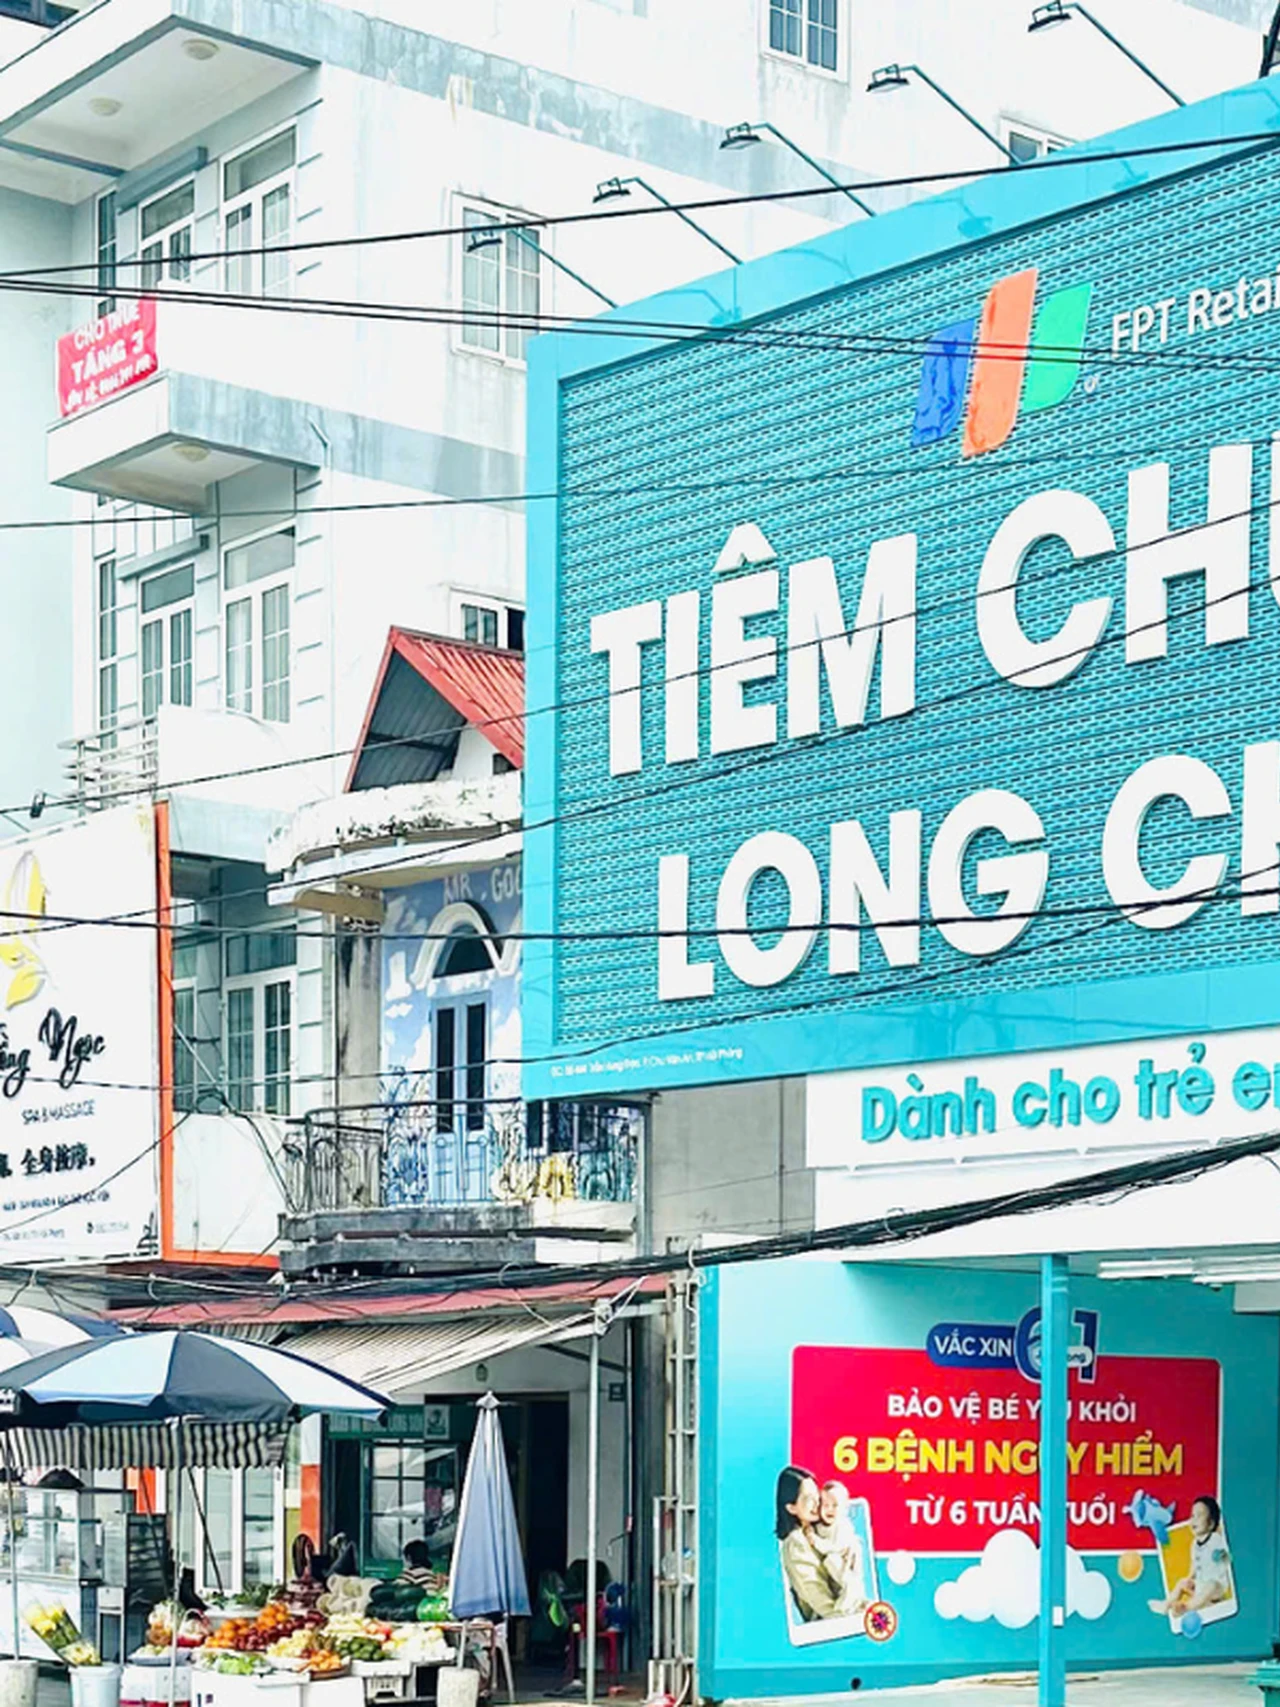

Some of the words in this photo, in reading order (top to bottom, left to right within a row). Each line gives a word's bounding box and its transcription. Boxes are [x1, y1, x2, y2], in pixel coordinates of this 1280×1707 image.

[1111, 298, 1176, 358] FPT
[590, 522, 918, 778] TIÊM
[657, 788, 1050, 1001] LONG
[860, 1073, 996, 1143] Dành
[1012, 1067, 1122, 1129] cho
[1134, 1042, 1216, 1120] trẻ
[934, 1328, 976, 1357] VẮC
[978, 1337, 1012, 1358] XIN
[887, 1387, 943, 1418] BẢO
[949, 1391, 982, 1425] VỆ
[988, 1393, 1020, 1420] BÉ
[1078, 1394, 1136, 1423] KHỎI
[833, 1436, 859, 1472] 6
[867, 1428, 975, 1483] BỆNH
[984, 1440, 1089, 1476] NGY
[1095, 1430, 1184, 1476] HIỂM
[906, 1493, 945, 1525] TỪ
[949, 1500, 967, 1525] 6
[973, 1492, 1042, 1526] TUẦN
[1066, 1492, 1115, 1525] UỔI
